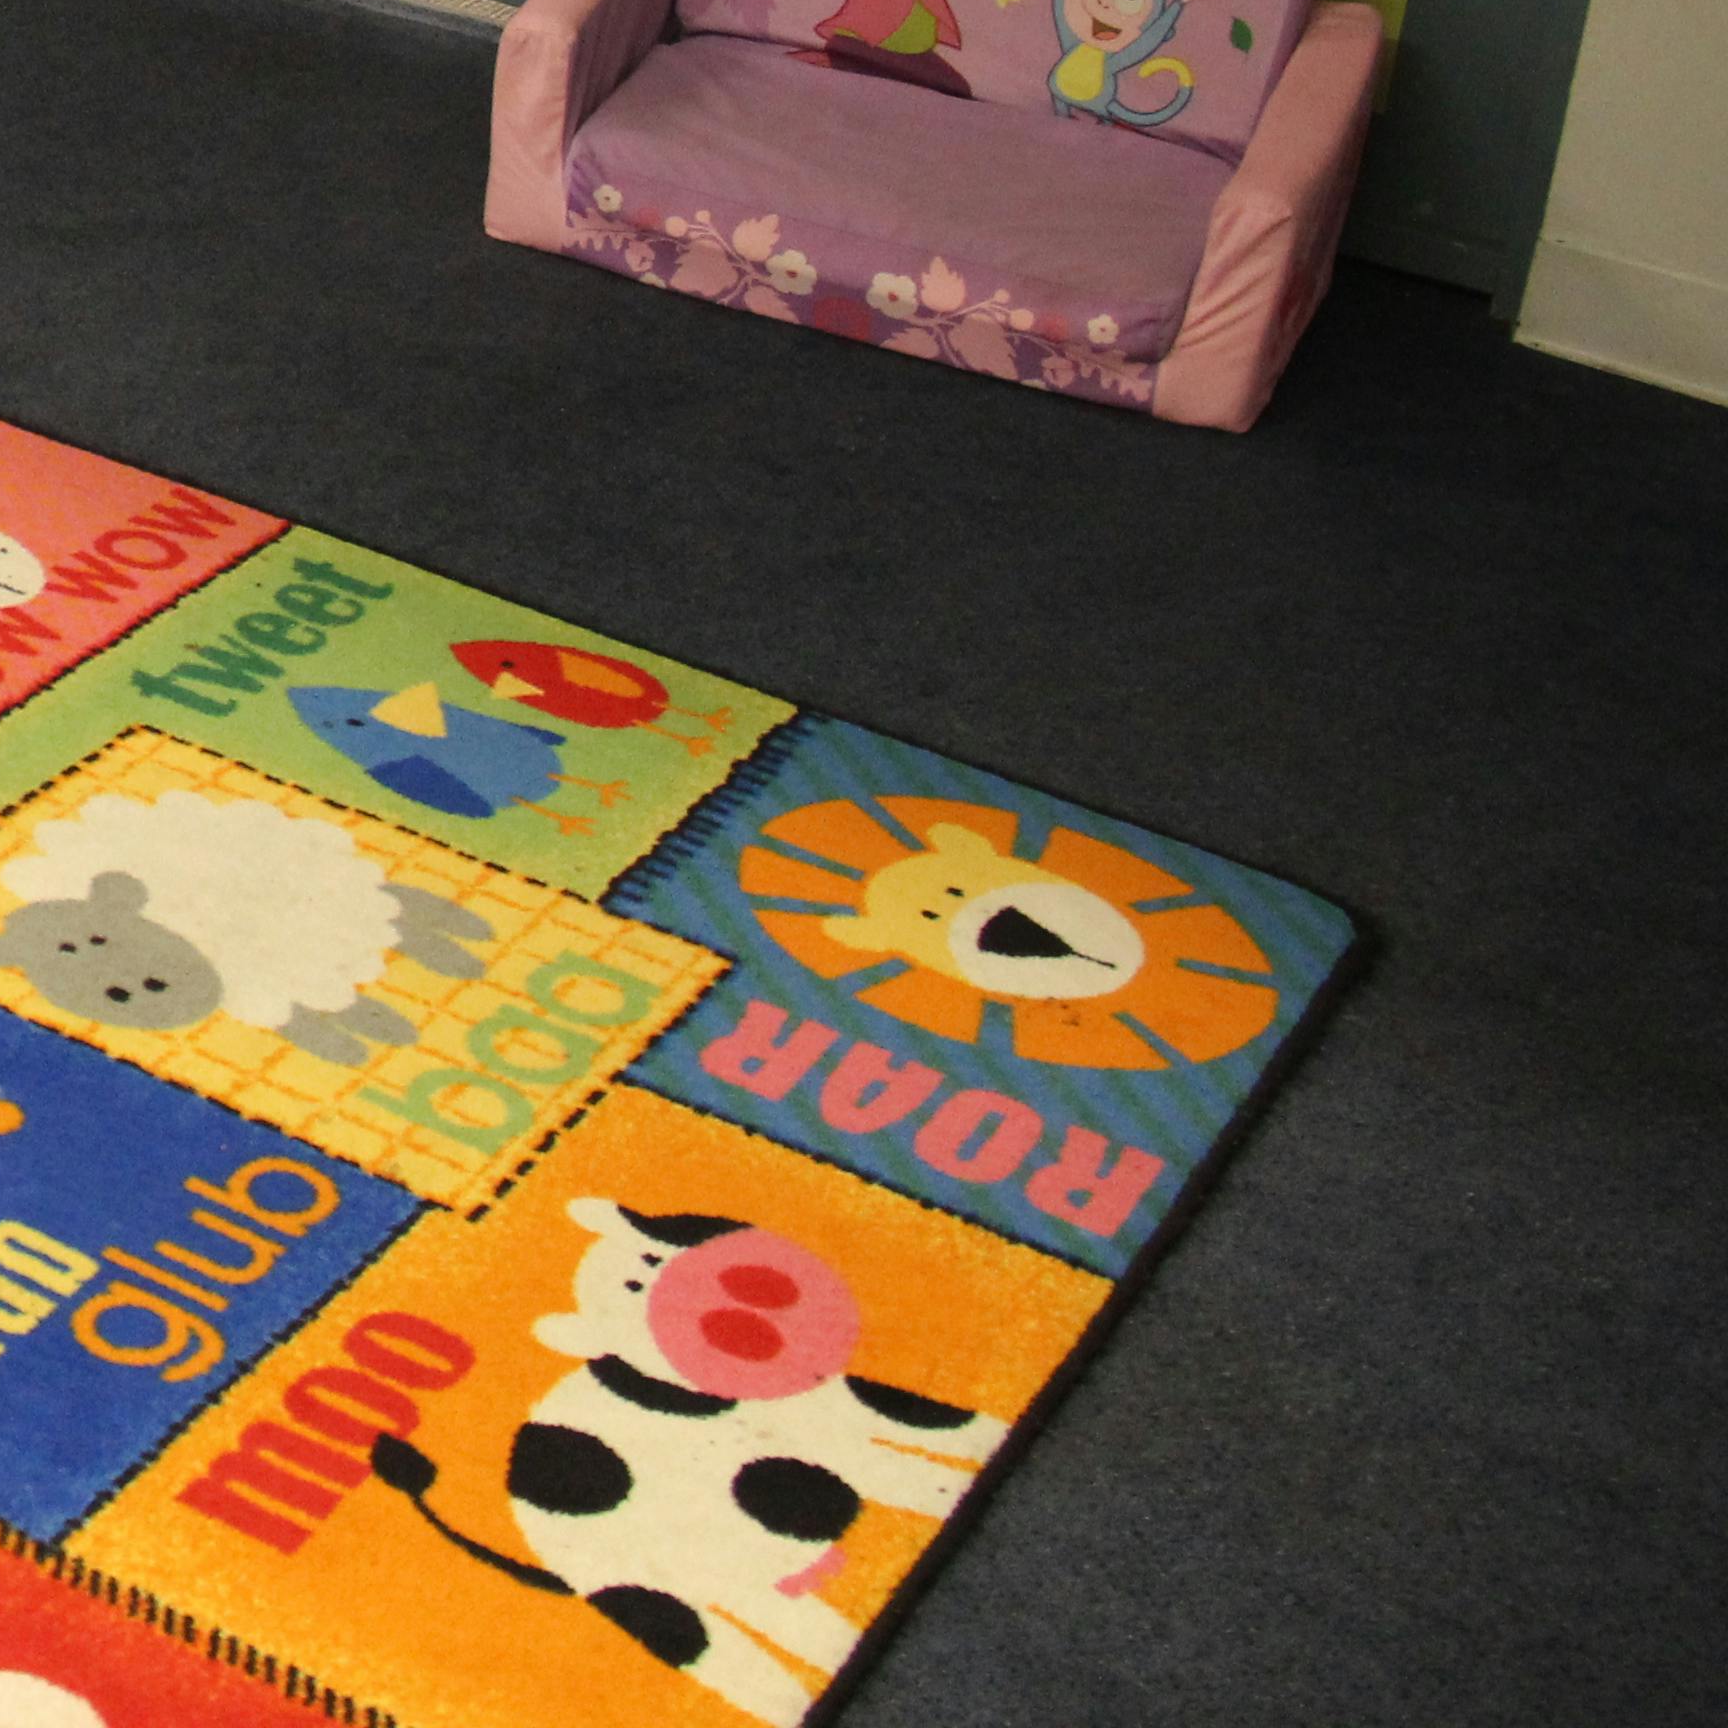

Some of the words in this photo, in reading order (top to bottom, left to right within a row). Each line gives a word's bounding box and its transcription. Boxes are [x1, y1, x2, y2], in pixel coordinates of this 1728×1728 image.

[70, 484, 238, 606] wow
[132, 555, 394, 718] tweet
[359, 949, 662, 1155] baa
[698, 998, 1166, 1238] ROAR
[70, 1156, 341, 1382] glub
[175, 1310, 476, 1557] moo
